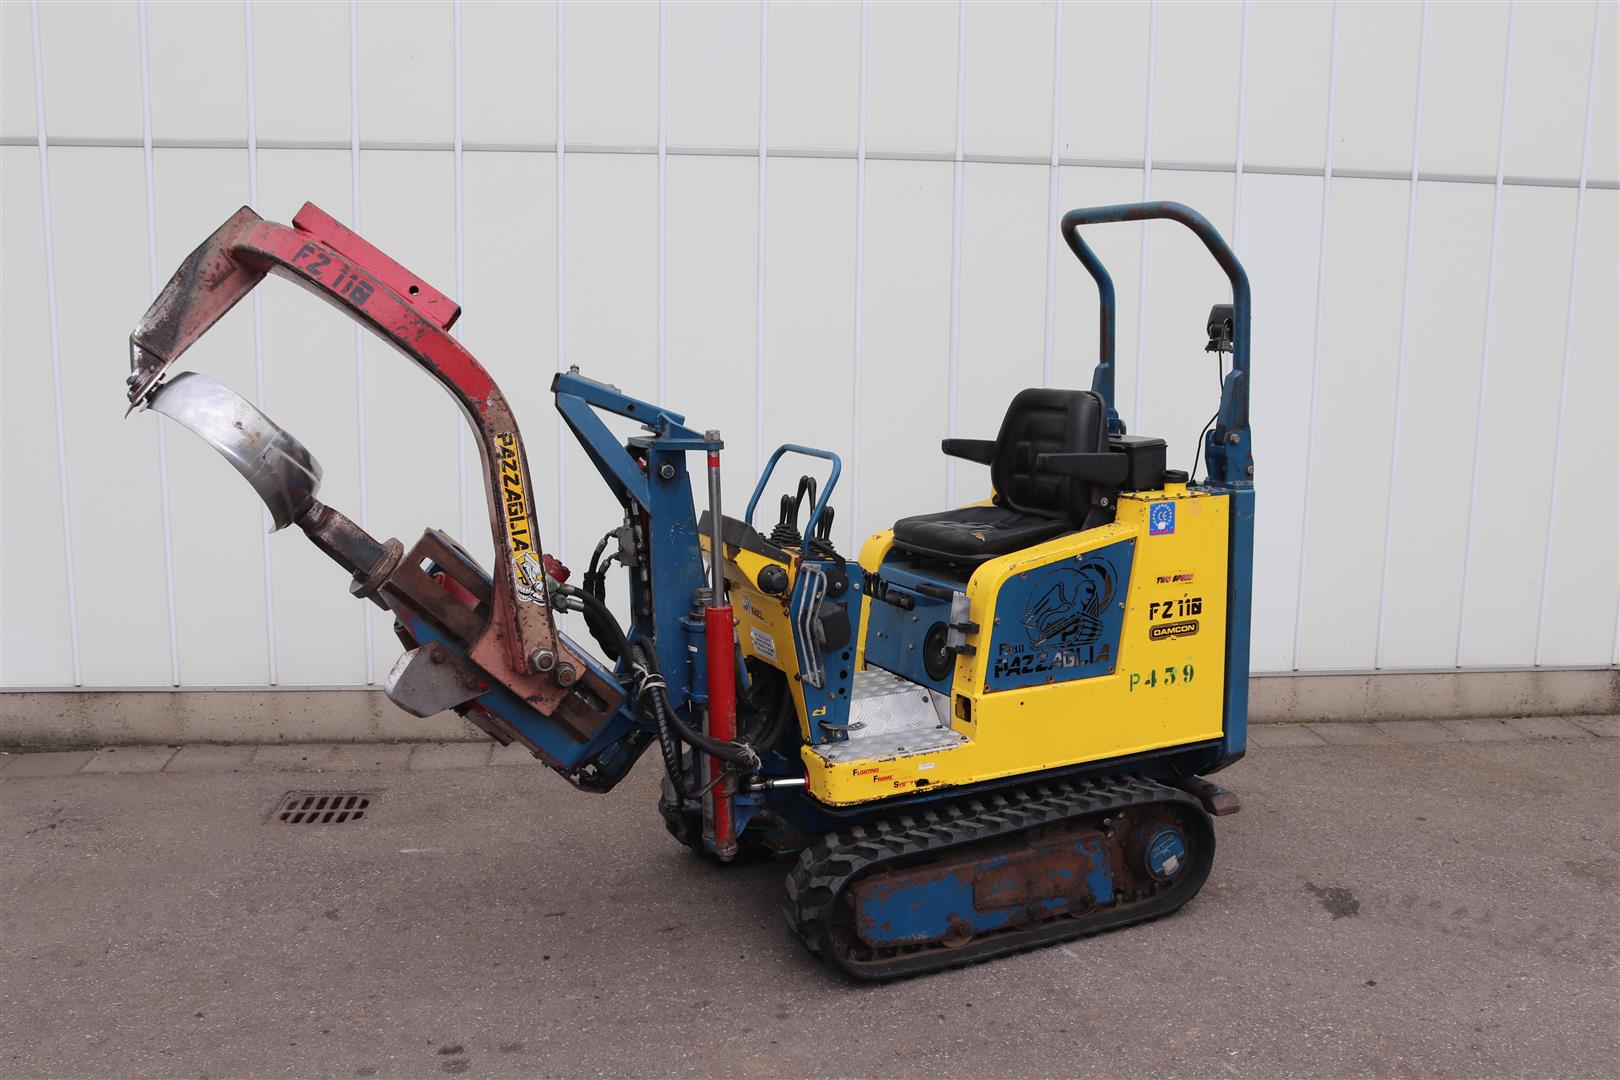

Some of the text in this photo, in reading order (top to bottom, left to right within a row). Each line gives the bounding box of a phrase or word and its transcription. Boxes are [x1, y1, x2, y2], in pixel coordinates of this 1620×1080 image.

[293, 244, 331, 275] FZ
[496, 432, 531, 552] PAZZAGLIA
[1158, 511, 1168, 521] CE
[1149, 602, 1174, 621] FZ
[1153, 624, 1196, 637] DAMCON
